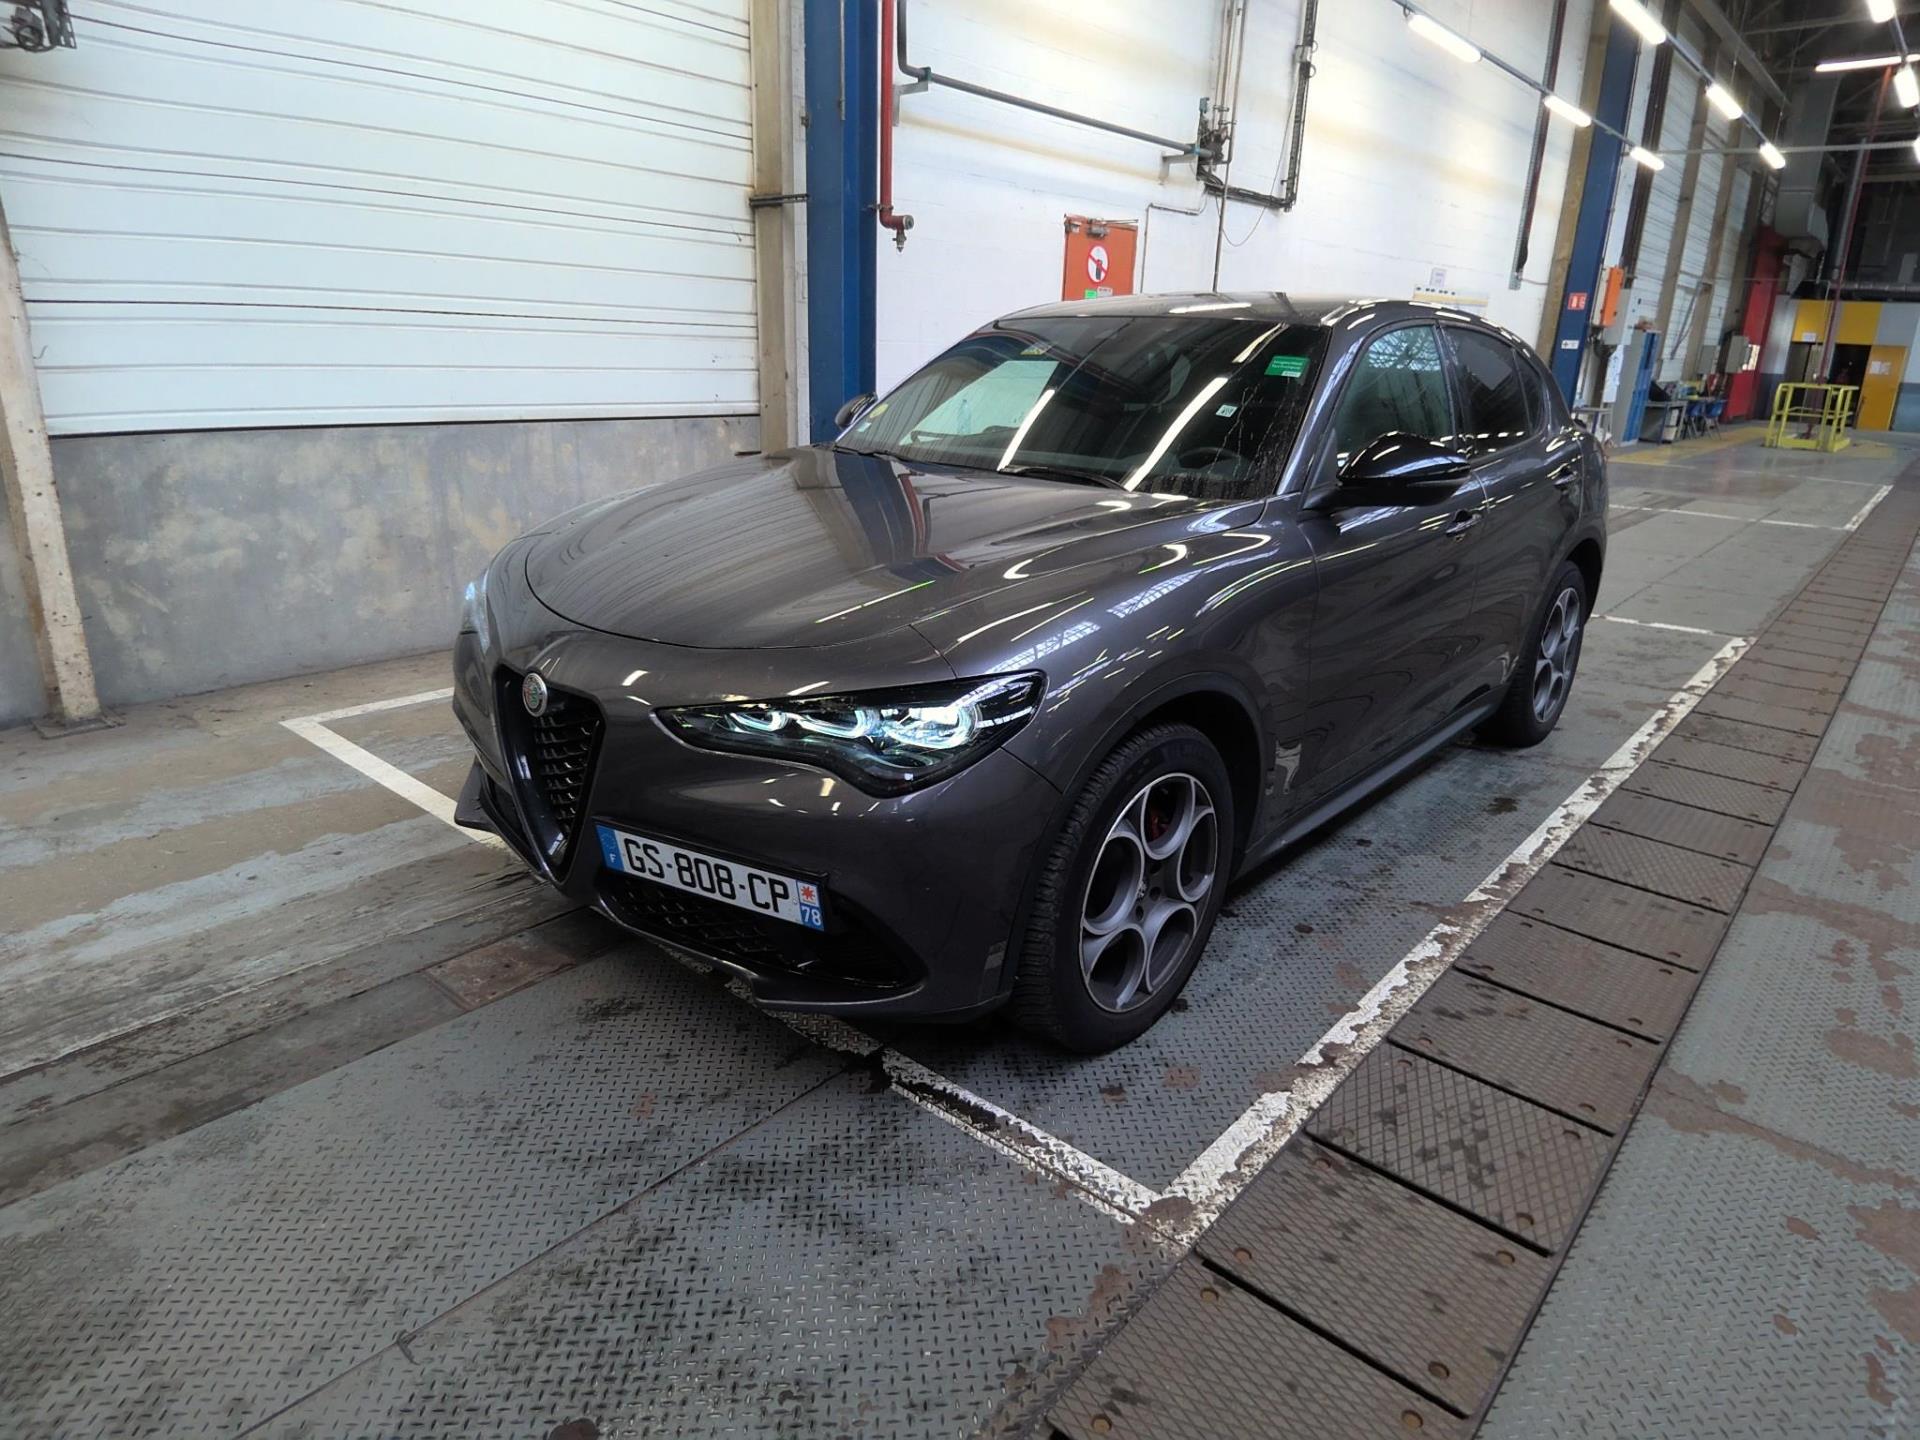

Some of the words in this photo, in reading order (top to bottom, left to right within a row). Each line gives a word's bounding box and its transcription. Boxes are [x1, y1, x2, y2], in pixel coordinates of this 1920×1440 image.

[609, 854, 616, 863] F
[624, 838, 789, 913] GS-808-CP
[801, 907, 822, 926] 78
